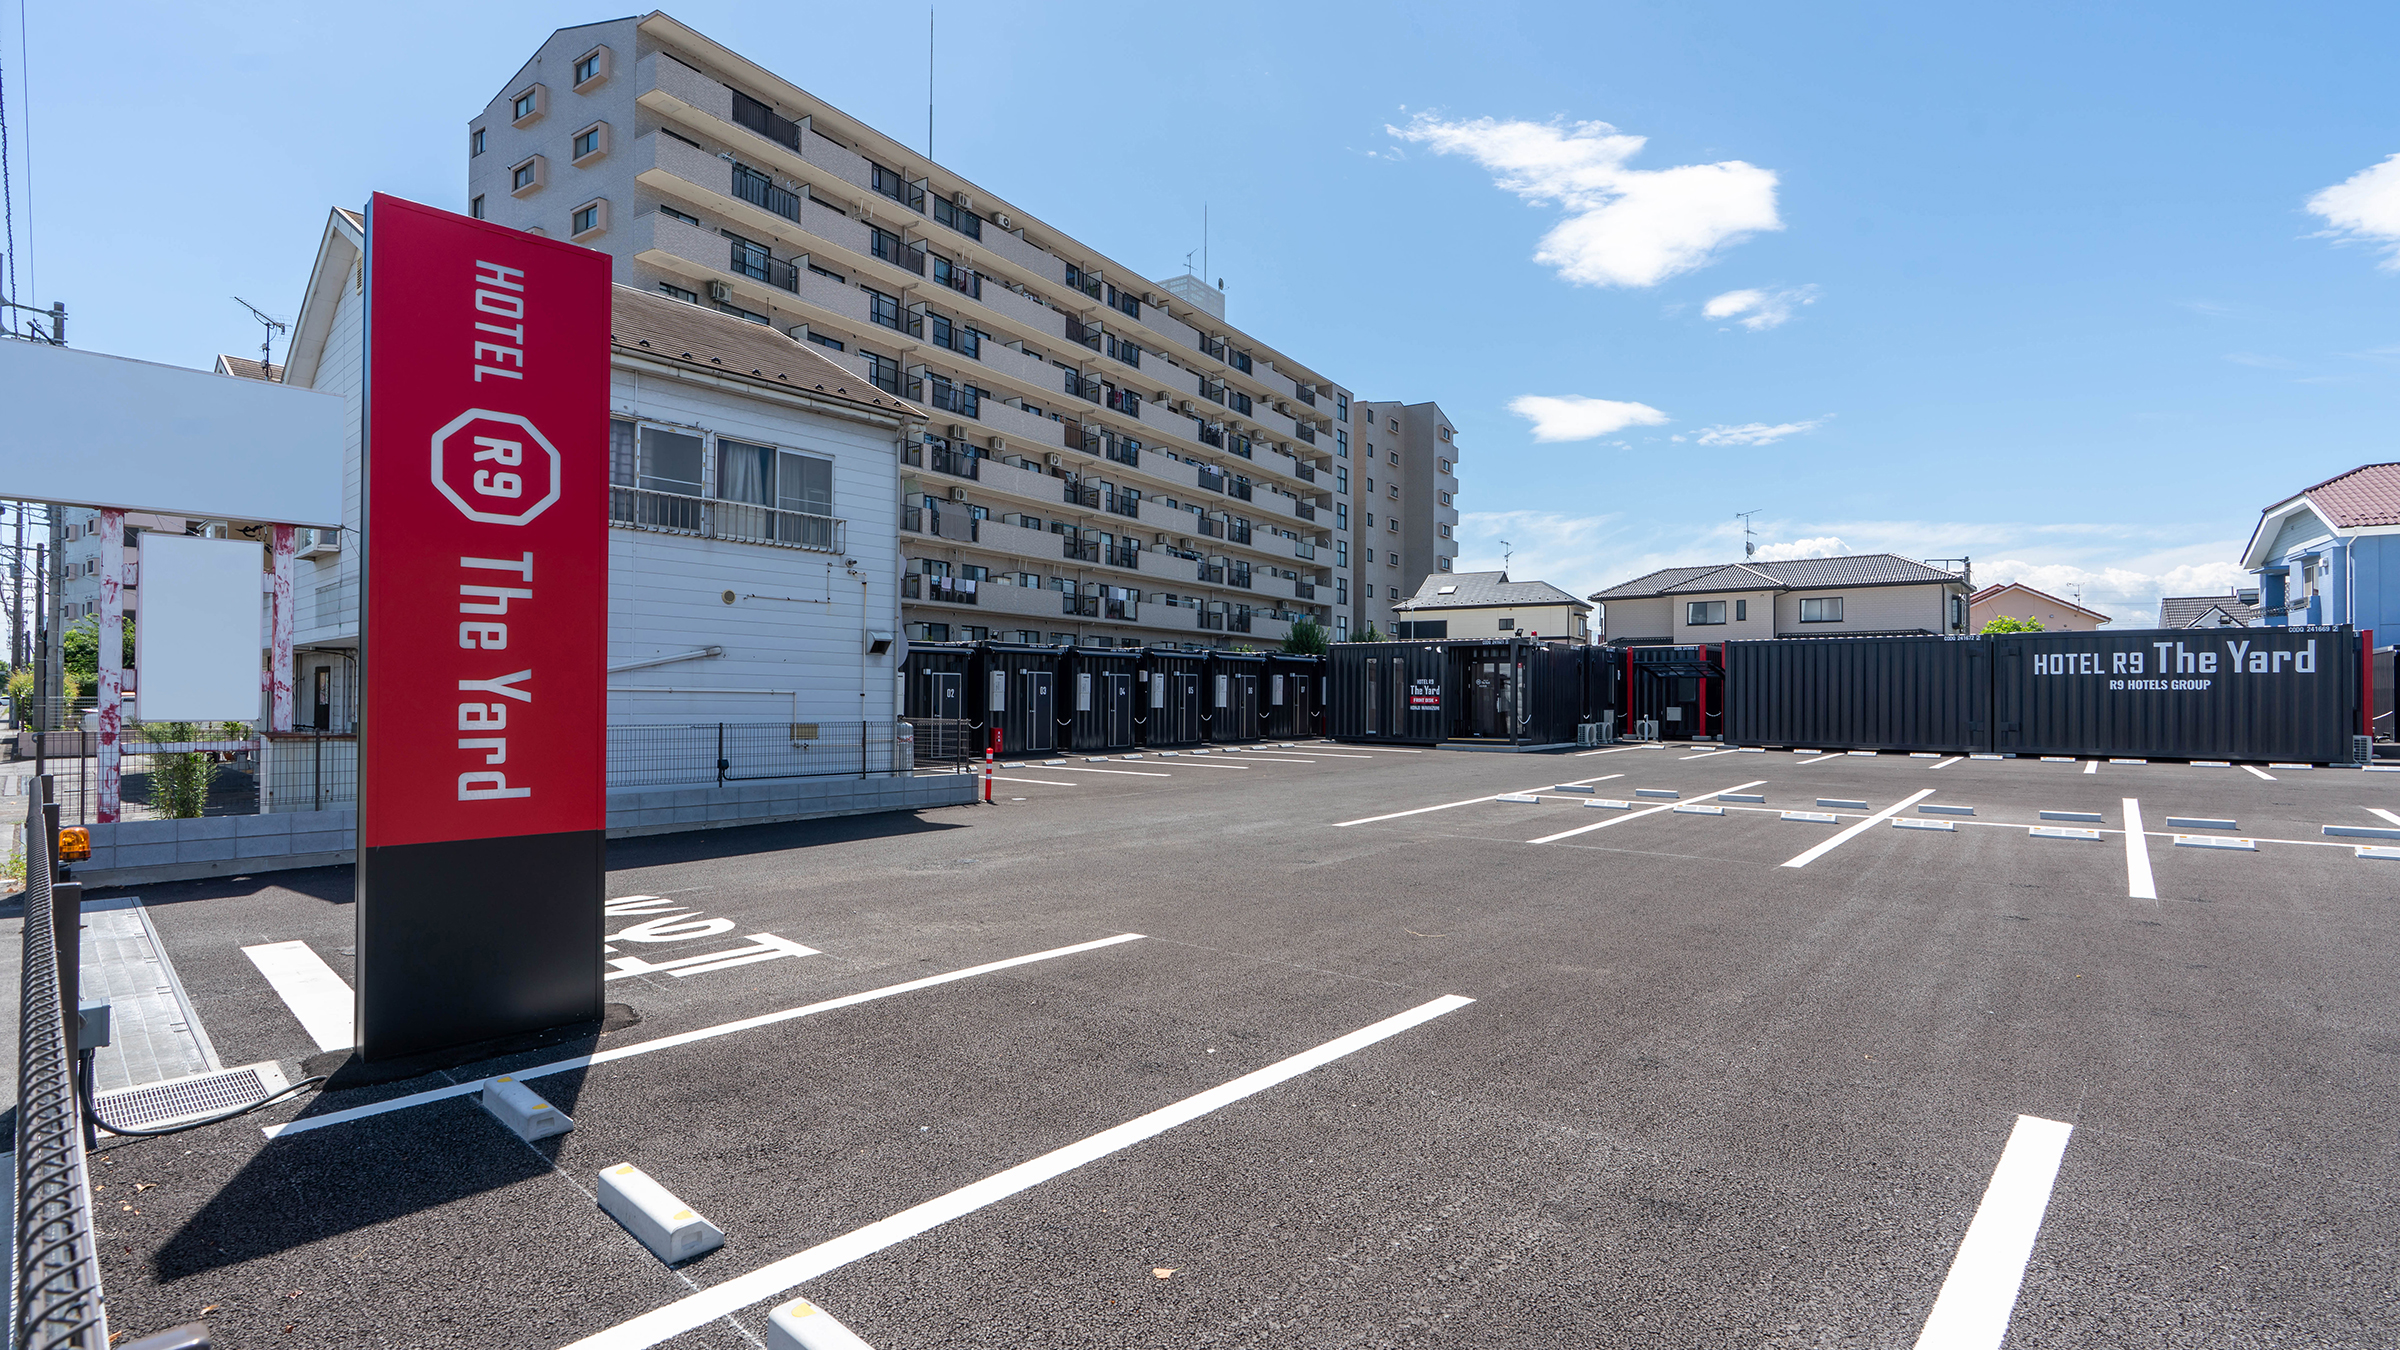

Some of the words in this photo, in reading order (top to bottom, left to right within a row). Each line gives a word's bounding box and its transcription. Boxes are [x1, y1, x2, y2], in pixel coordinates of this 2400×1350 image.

[474, 259, 525, 382] HOTEL
[473, 435, 522, 498] R9
[459, 551, 533, 650] The
[2034, 653, 2105, 675] HOTEL
[2112, 652, 2144, 674] R9
[2153, 642, 2217, 674] The
[2226, 639, 2316, 673] Yard
[946, 688, 955, 698] 02
[1039, 686, 1047, 695] 03
[1119, 687, 1126, 695] 04
[1410, 685, 1423, 695] The
[1424, 685, 1440, 695] Yard
[2109, 680, 2124, 690] R9
[2127, 680, 2168, 690] HOTELS
[2171, 680, 2212, 690] GROUP
[457, 668, 532, 802] Yard
